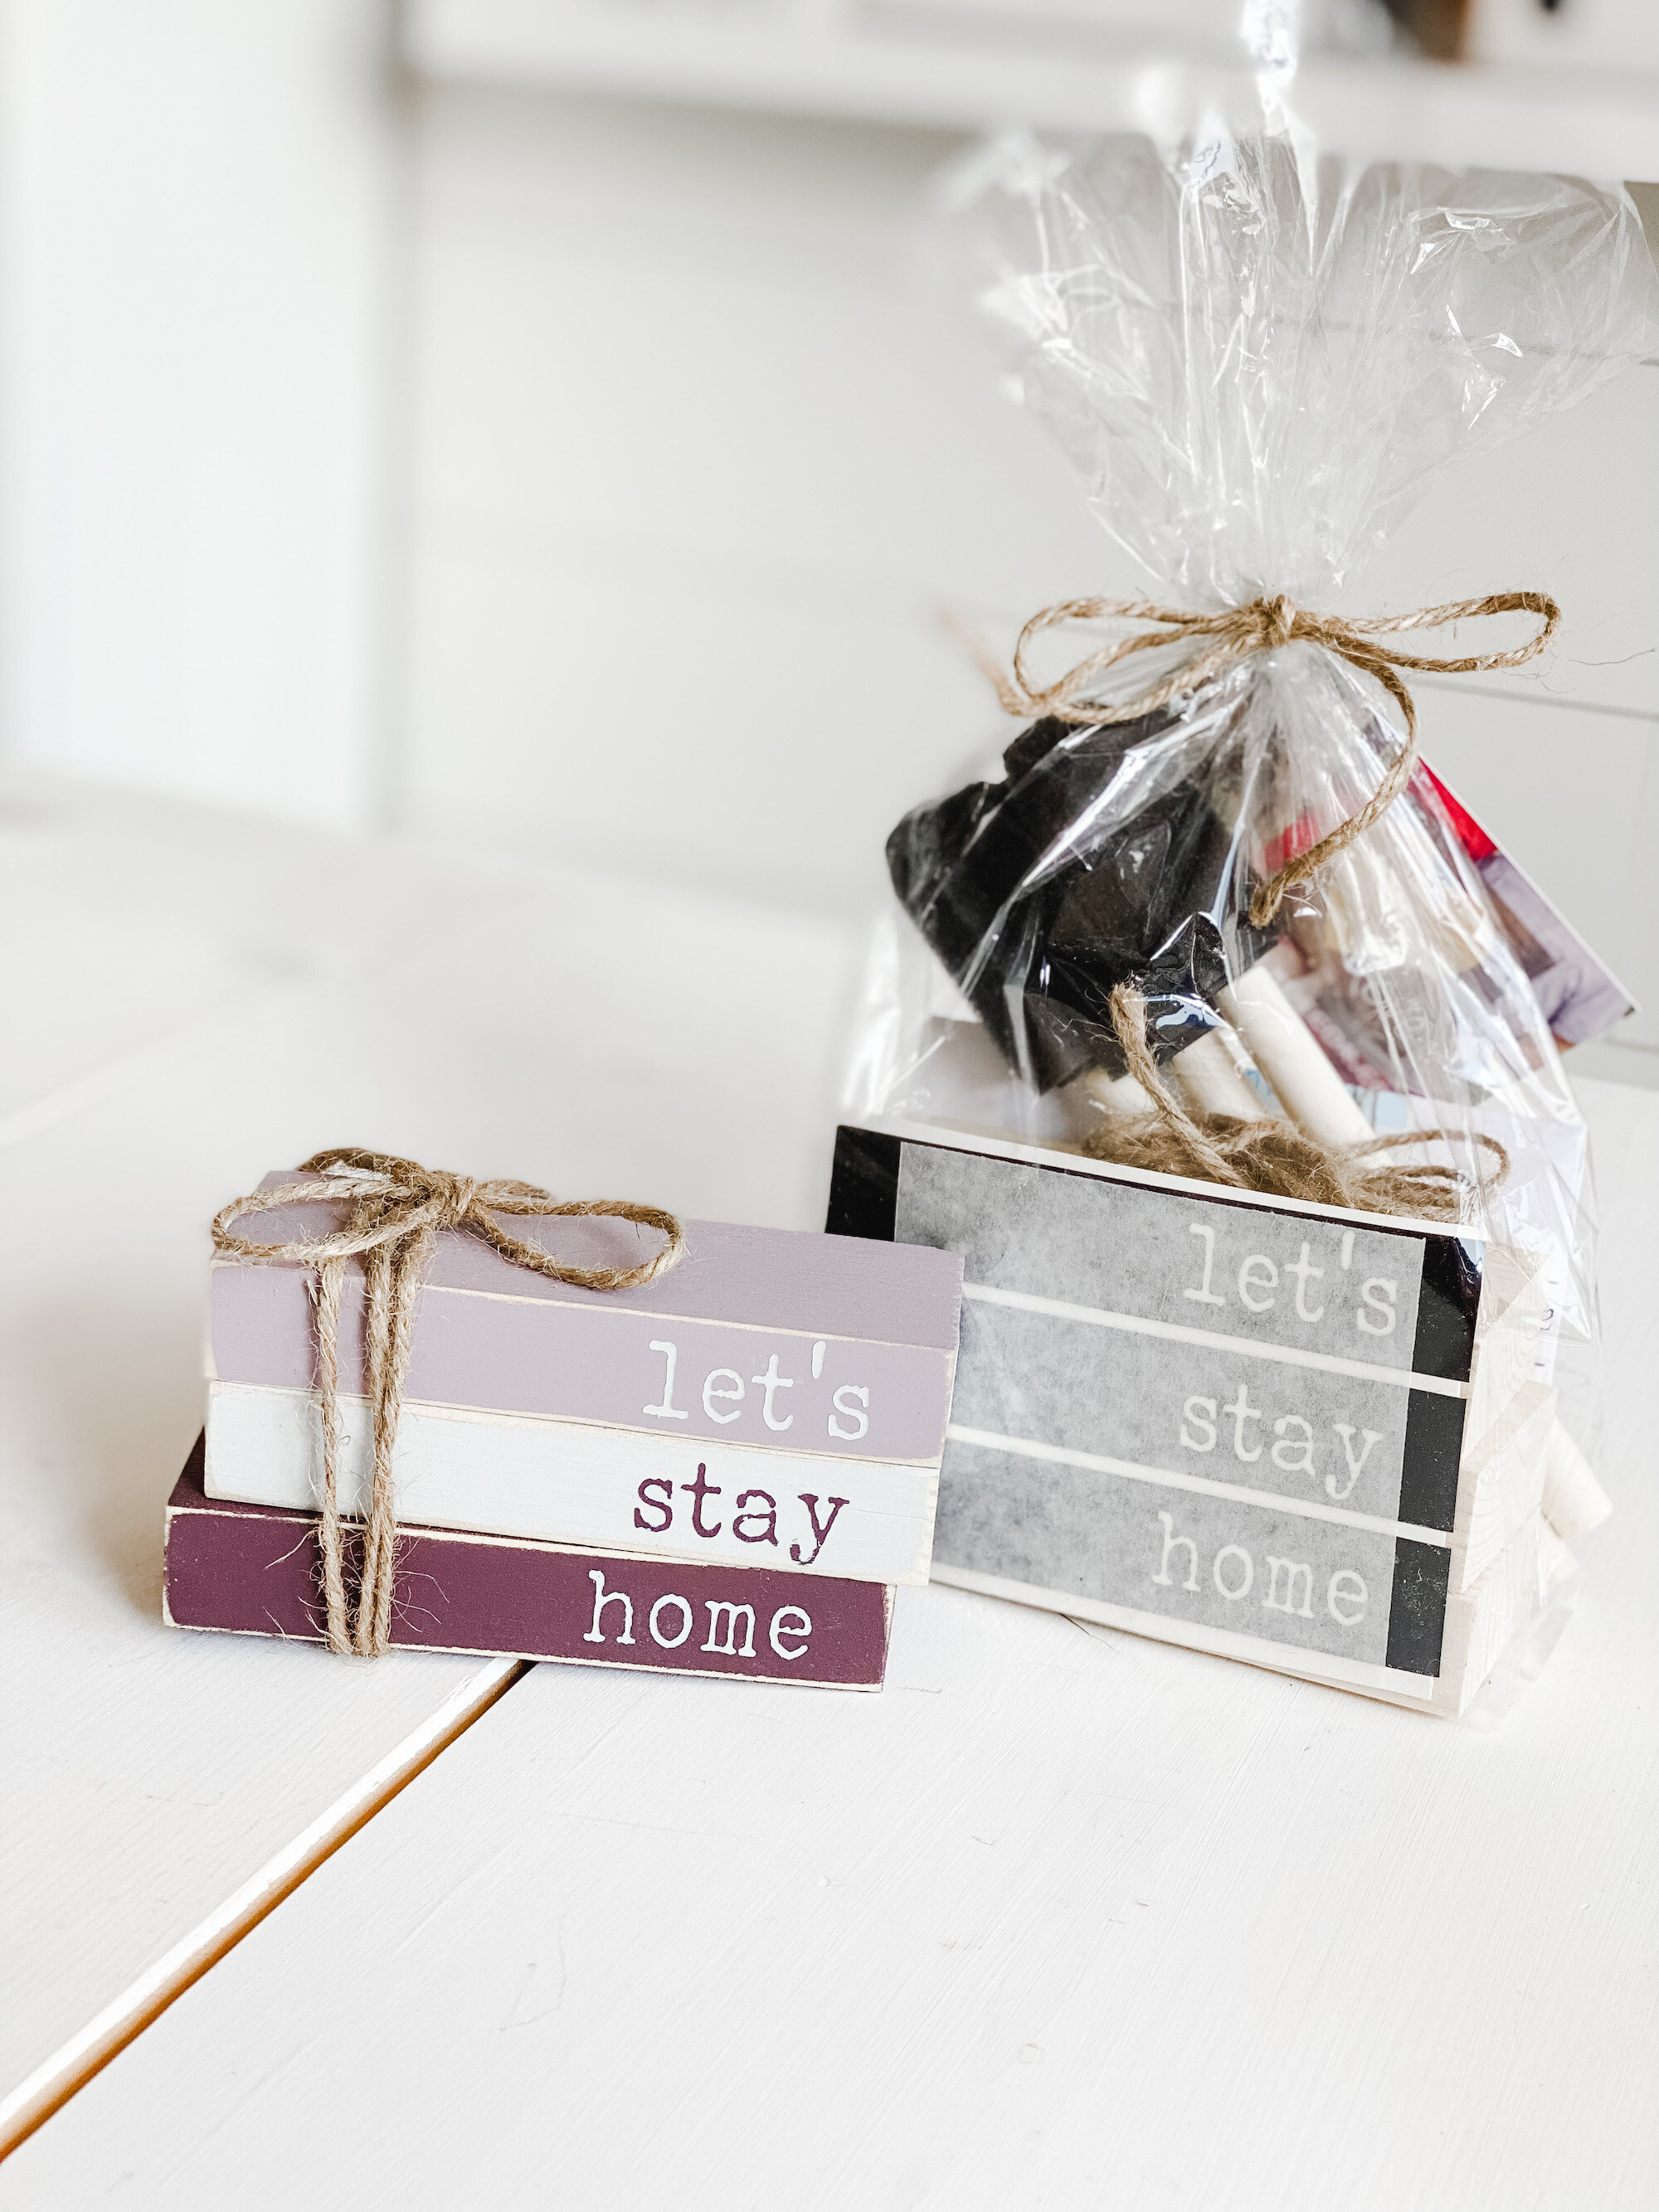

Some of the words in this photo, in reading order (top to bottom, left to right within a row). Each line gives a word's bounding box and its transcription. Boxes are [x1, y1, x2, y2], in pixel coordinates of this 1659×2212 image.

[1184, 1223, 1397, 1336] let's
[642, 1339, 870, 1441] let's
[1180, 1383, 1384, 1500] stay
[633, 1462, 850, 1565] stay
[582, 1569, 813, 1660] home
[1151, 1510, 1370, 1626] home
